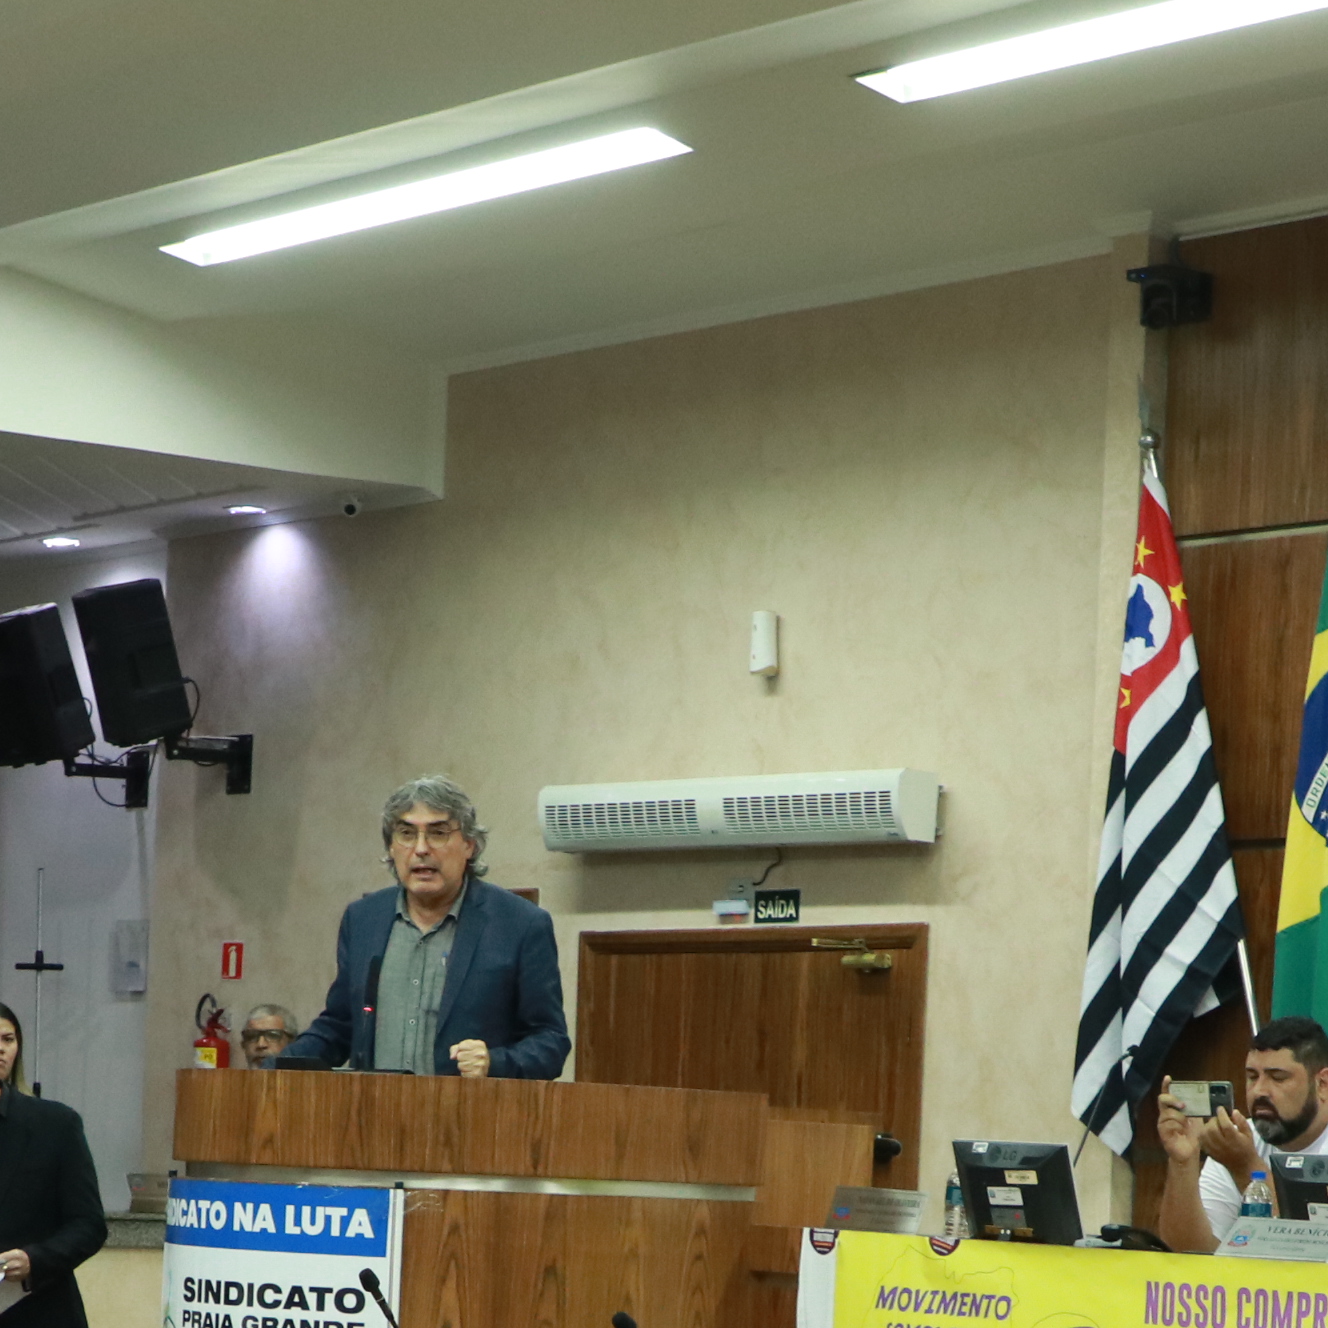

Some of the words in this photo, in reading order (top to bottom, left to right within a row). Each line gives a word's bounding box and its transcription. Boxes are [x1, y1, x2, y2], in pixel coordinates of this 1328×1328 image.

[757, 895, 797, 919] SAÍDA
[233, 1202, 276, 1233] NA
[285, 1204, 375, 1239] LUTA
[1267, 1226, 1292, 1236] VERA
[183, 1276, 366, 1314] SINDICATO
[875, 1285, 1012, 1321] MOVIMENTO
